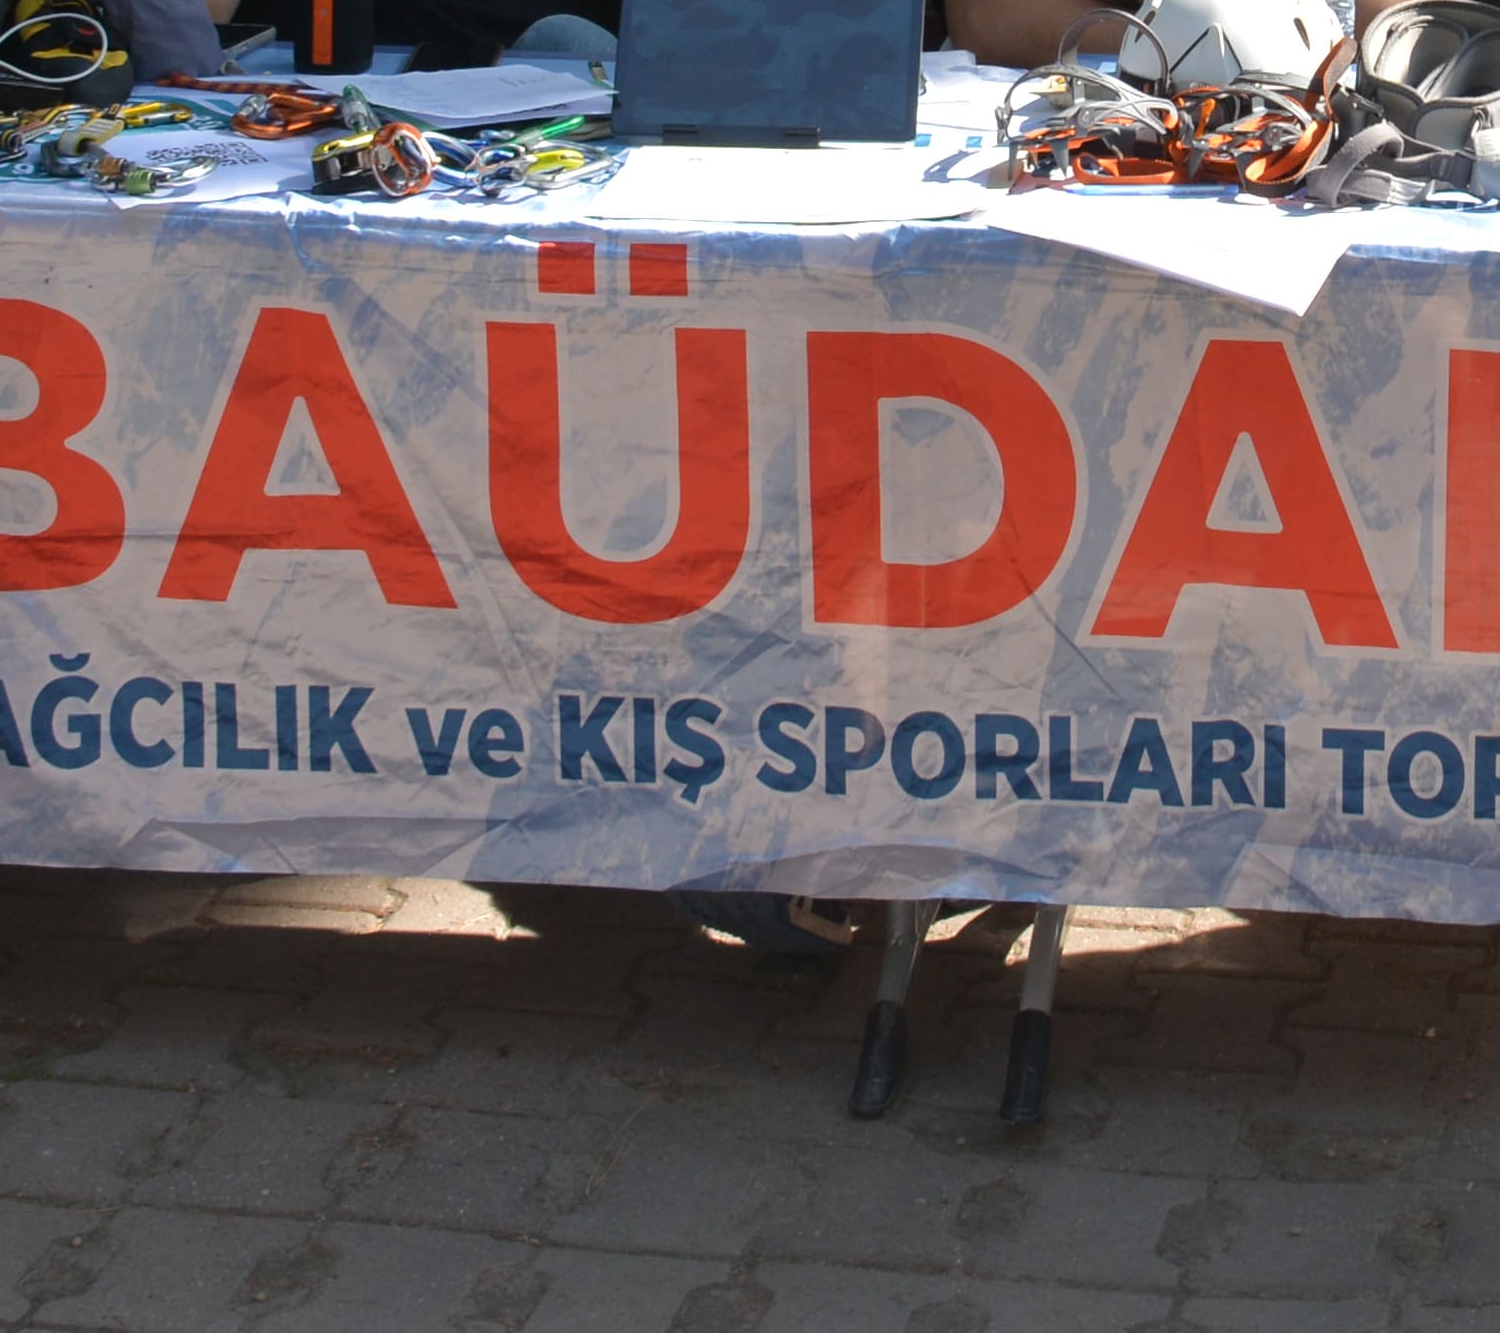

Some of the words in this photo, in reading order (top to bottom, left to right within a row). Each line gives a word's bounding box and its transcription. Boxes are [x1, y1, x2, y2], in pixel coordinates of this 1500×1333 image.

[405, 704, 526, 780] ve
[558, 693, 728, 804] KIŞ
[756, 701, 1288, 811] SPORLARI
